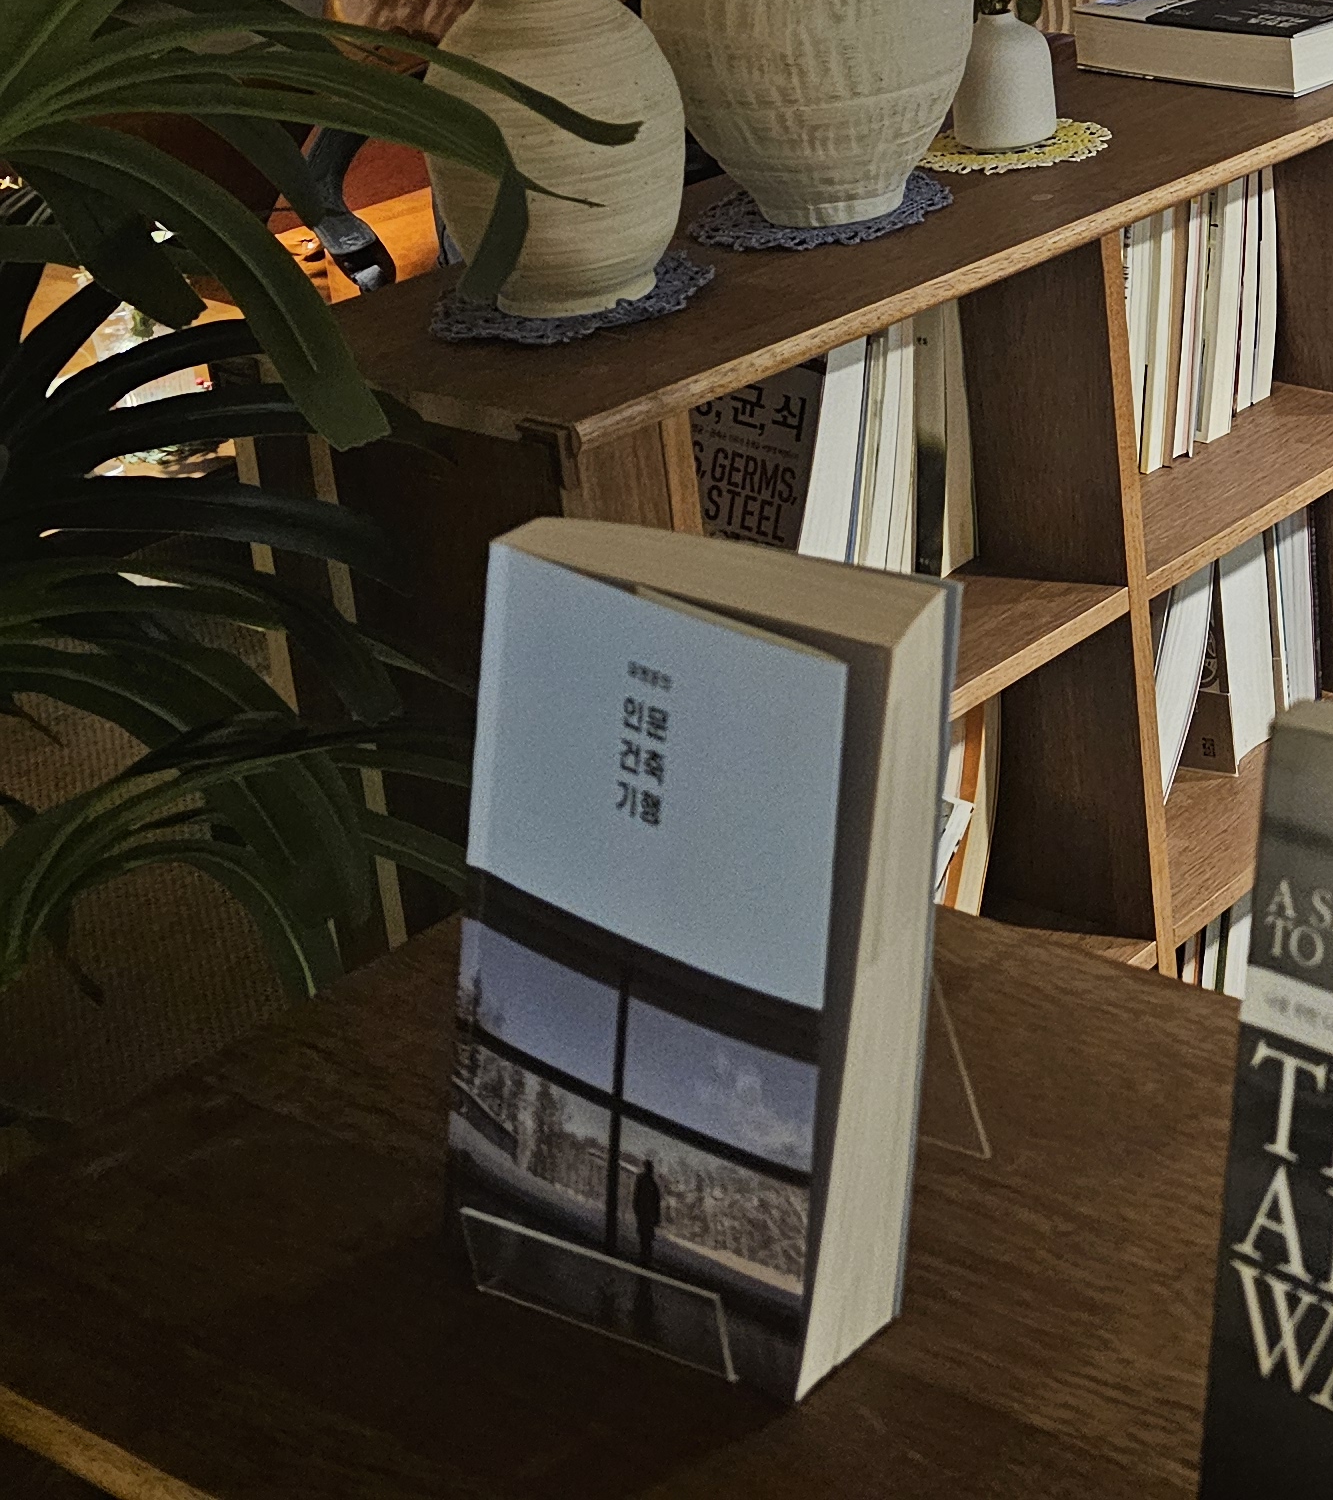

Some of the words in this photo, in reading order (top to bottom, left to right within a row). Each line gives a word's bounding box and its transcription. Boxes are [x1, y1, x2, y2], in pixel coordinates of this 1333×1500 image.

[710, 447, 798, 506] GERMS,
[704, 484, 785, 543] STEEL
[623, 696, 669, 744] 인문
[620, 737, 665, 786] 건축
[615, 779, 662, 827] 기행
[1265, 879, 1296, 920] A
[1264, 914, 1325, 969] TO
